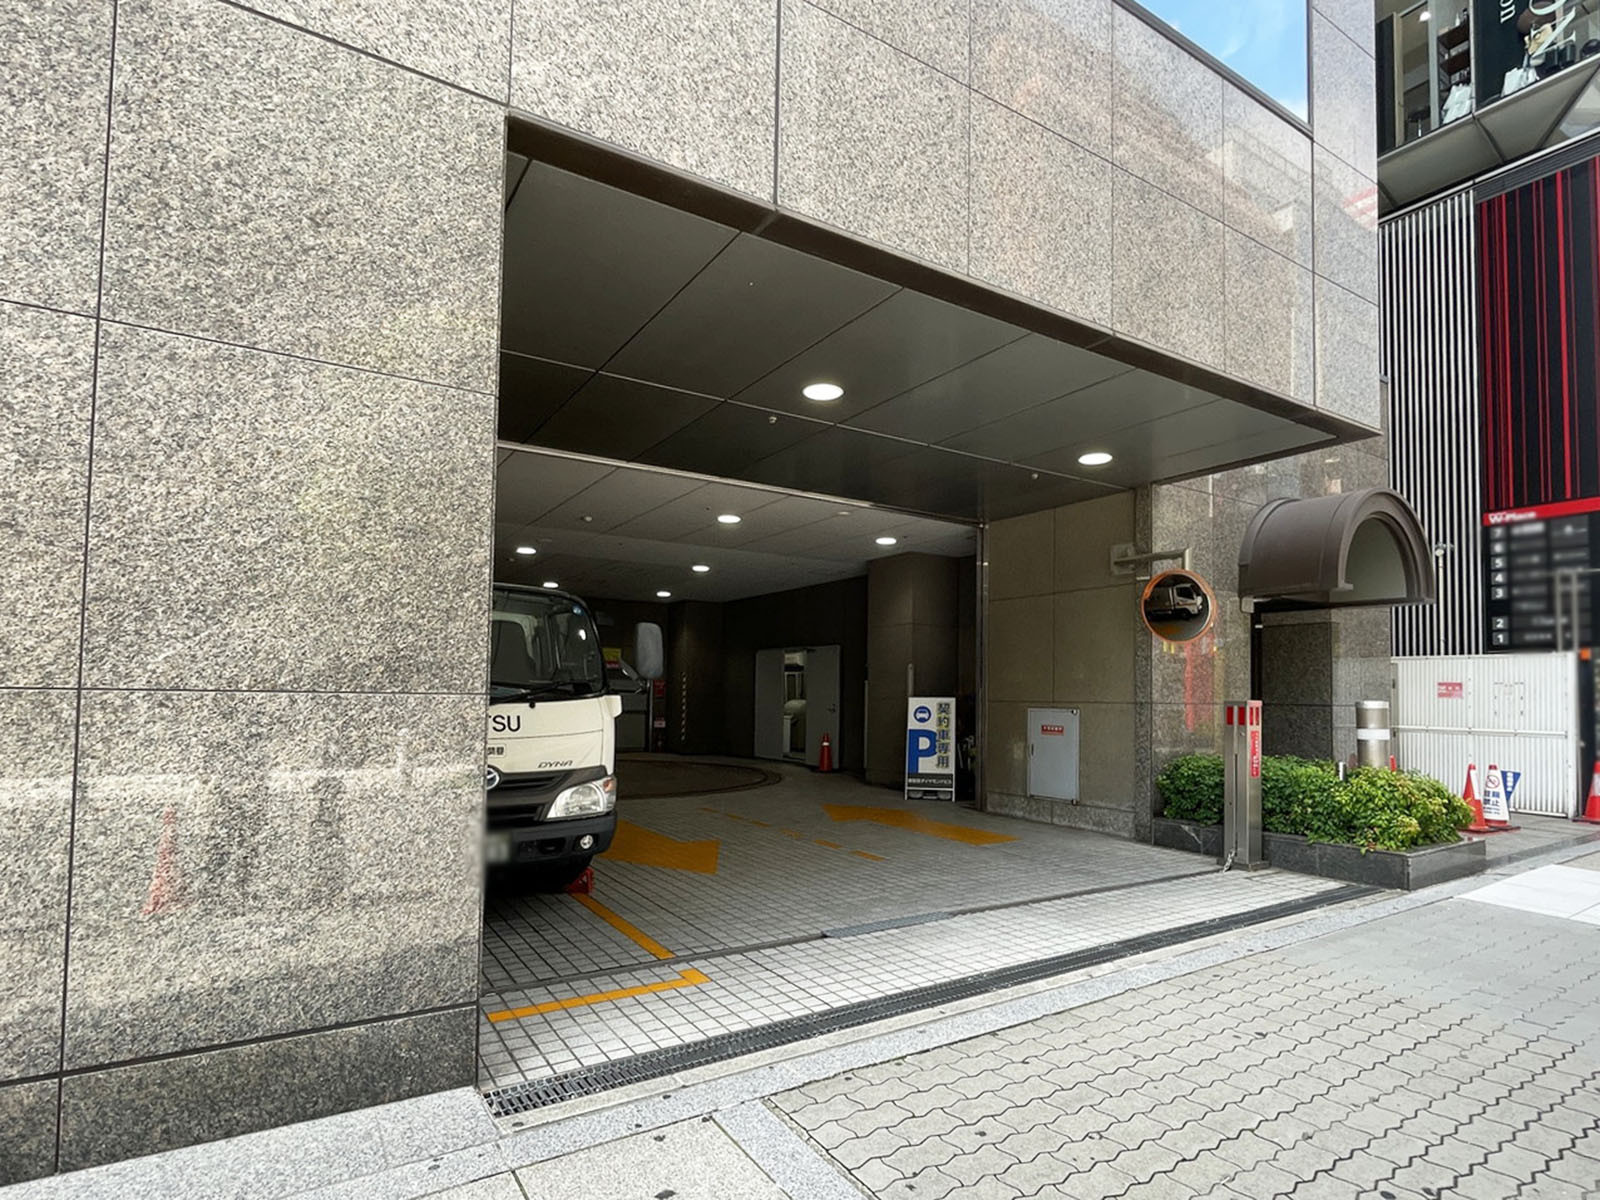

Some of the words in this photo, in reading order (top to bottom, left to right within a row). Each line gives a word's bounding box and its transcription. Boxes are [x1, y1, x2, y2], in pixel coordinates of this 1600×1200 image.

[1495, 558, 1502, 568] 5
[1494, 573, 1503, 583] 4
[1495, 588, 1503, 599] 3
[1496, 618, 1504, 629] 2
[488, 714, 521, 732] SU
[936, 702, 951, 769] 契約車専用
[908, 729, 937, 774] P
[537, 760, 573, 769] DYNA
